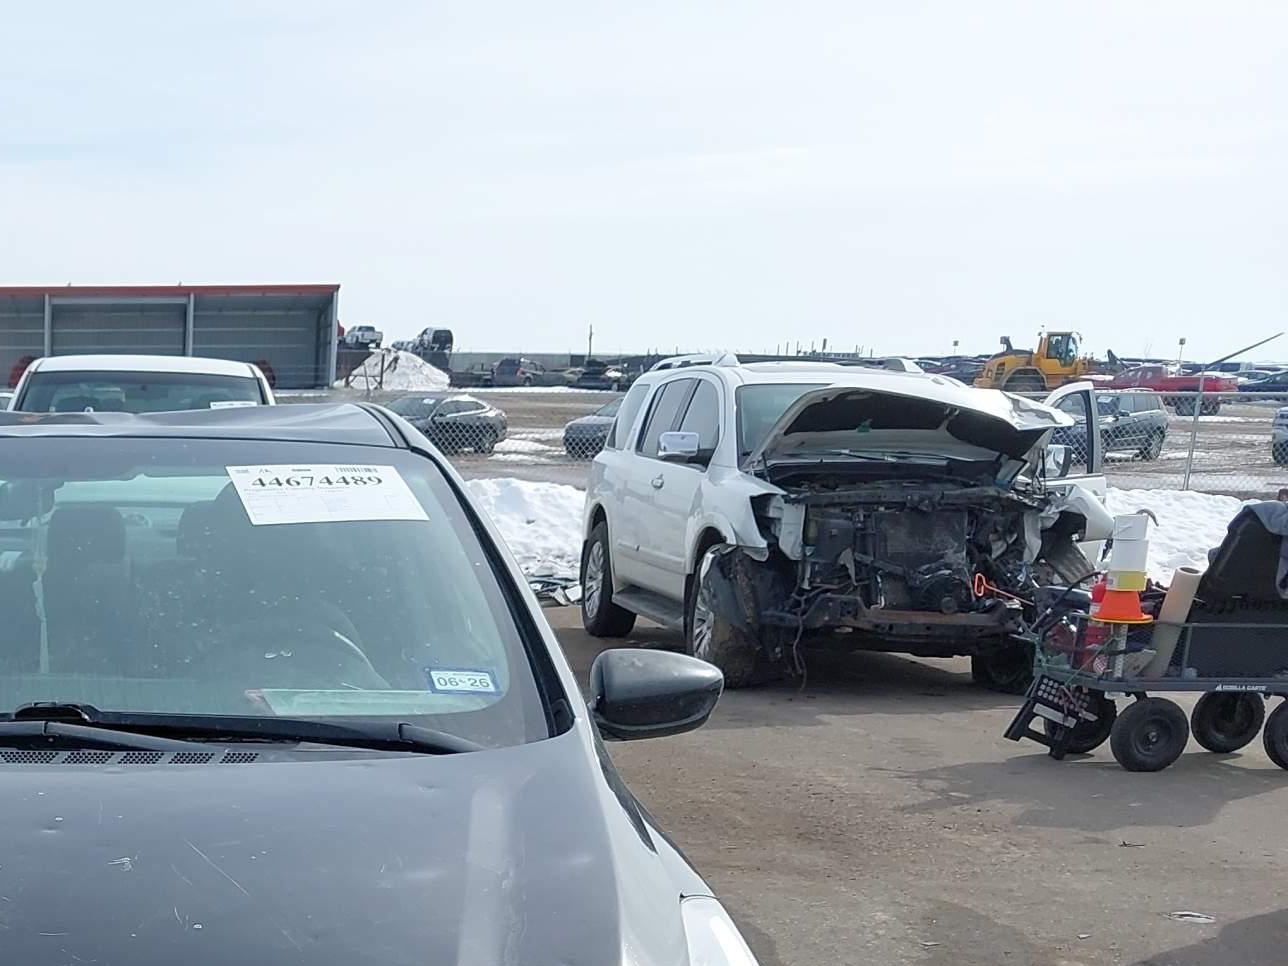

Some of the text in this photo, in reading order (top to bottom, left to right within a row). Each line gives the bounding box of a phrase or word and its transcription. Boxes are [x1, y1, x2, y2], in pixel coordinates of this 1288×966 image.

[251, 474, 383, 488] 44674489
[436, 676, 490, 688] 06 26
